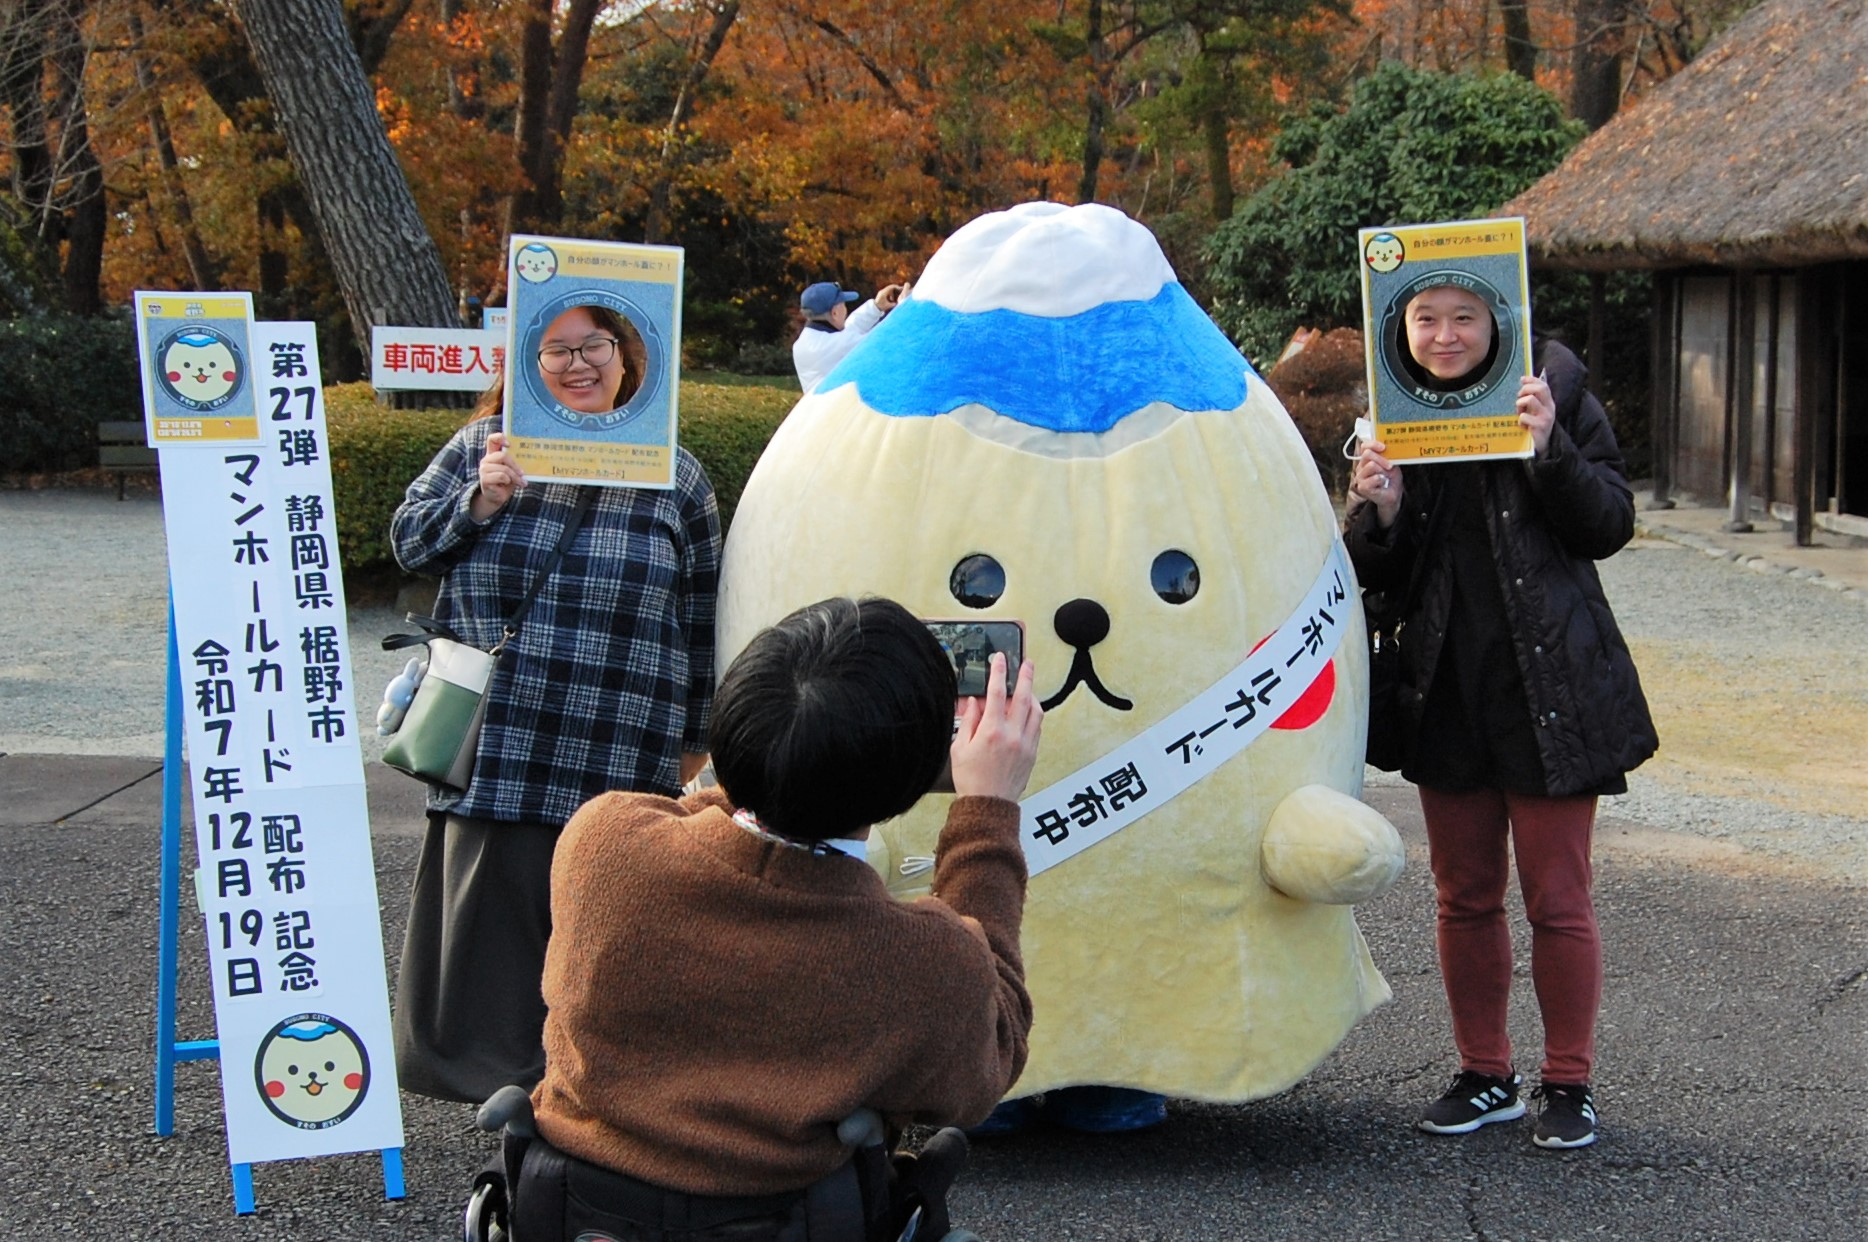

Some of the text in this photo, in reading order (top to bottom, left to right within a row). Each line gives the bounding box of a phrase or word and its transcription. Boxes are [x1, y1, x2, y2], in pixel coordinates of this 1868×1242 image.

[563, 294, 627, 311] SUSONO CITY
[1413, 275, 1476, 293] SUSONO CITY
[1414, 386, 1438, 402] すその
[269, 342, 346, 743] 第27弾 静岡県 裾野市
[224, 454, 319, 992] マンホールカード 配布記念
[1032, 569, 1346, 846] マンホールカード 配布中
